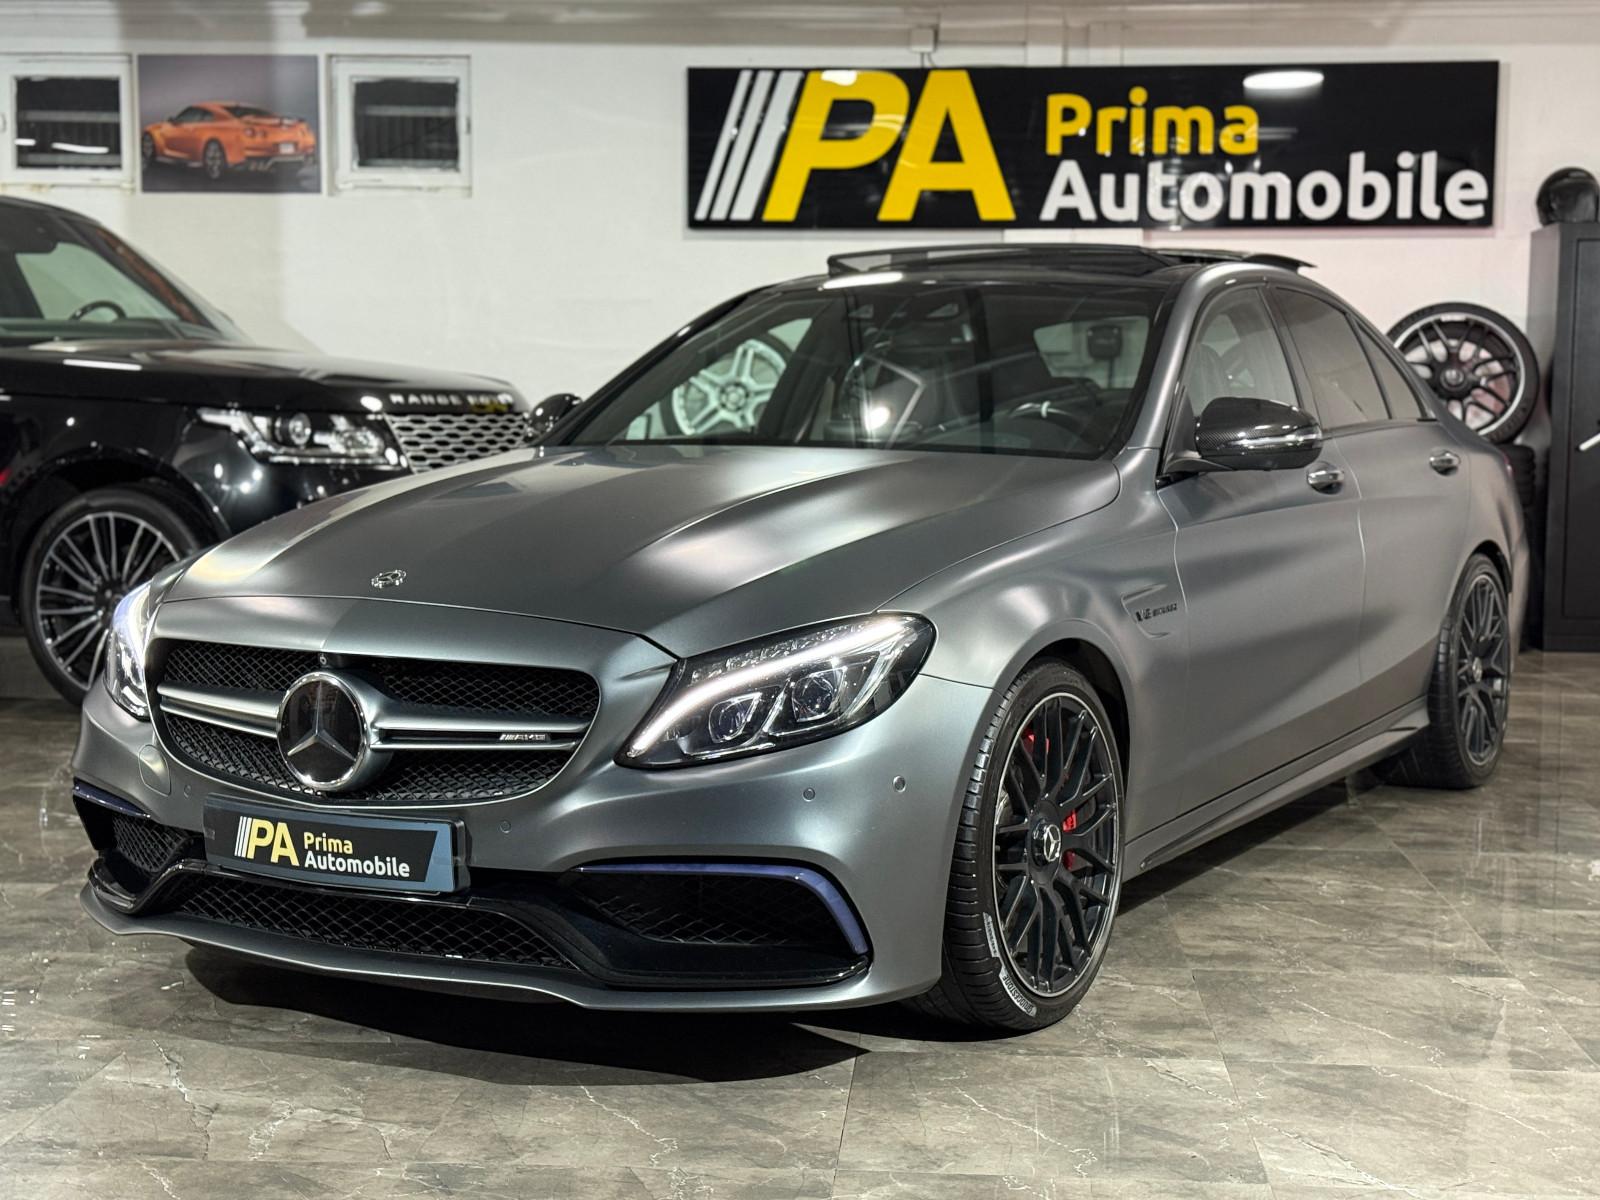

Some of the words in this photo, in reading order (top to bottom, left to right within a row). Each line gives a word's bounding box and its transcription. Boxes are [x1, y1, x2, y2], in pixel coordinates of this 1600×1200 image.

[762, 69, 1016, 222] PA
[1045, 86, 1259, 156] Prima
[1039, 150, 1489, 222] Automobile
[246, 818, 300, 867] PA
[303, 831, 353, 855] Prima
[304, 851, 410, 878] Automobile
